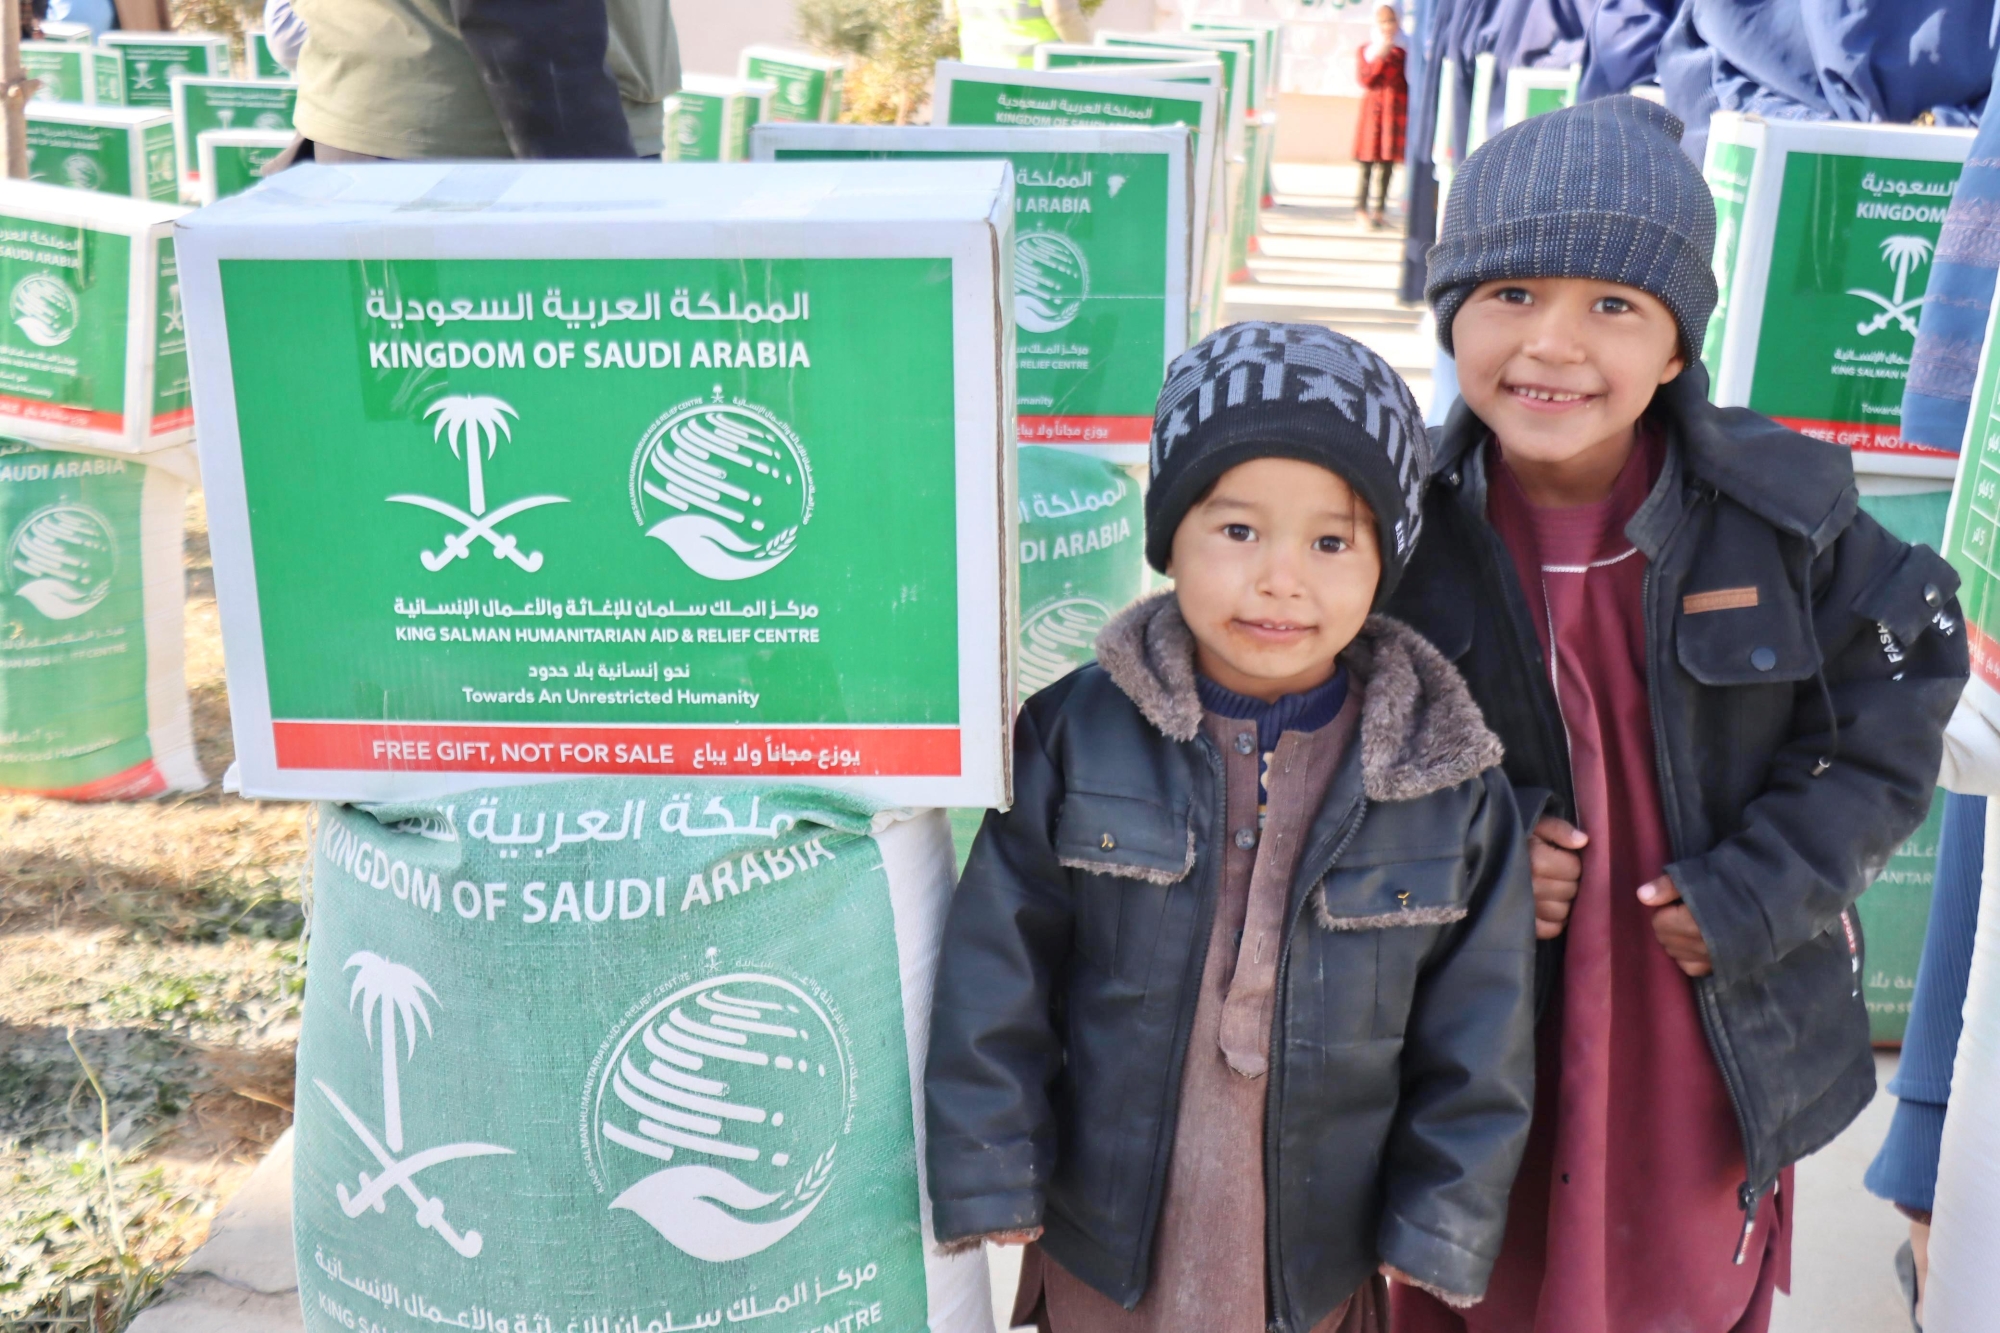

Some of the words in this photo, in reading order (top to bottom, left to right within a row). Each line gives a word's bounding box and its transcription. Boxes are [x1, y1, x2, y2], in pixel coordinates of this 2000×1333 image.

[1016, 168, 1092, 189] المملكة
[1025, 198, 1091, 213] ARABIA
[1856, 202, 1948, 224] KINGDOM
[366, 289, 533, 329] السعودية
[542, 289, 661, 329] العربية
[670, 288, 809, 324] المملكة
[369, 341, 525, 368] KINGDOM
[533, 342, 575, 368] OF
[584, 342, 681, 368] SAUDI
[689, 342, 811, 369] ARABIA
[1020, 361, 1050, 369] RELIEF
[1051, 361, 1089, 369] CENTRE
[1016, 396, 1054, 407] umanity
[0, 464, 49, 482] AUDI
[52, 459, 126, 479] ARABIA
[1033, 478, 1127, 518] المملكة
[1053, 518, 1131, 559] ARABIA
[394, 597, 479, 620] الإنسانية
[482, 596, 563, 619] والأعمال
[566, 597, 633, 619] للإغاثة
[635, 600, 707, 619] سلمان
[709, 600, 766, 618] الملك
[769, 600, 819, 620] مركز
[396, 627, 436, 642] KING
[440, 627, 512, 643] SALMAN
[516, 627, 646, 643] HUMANITARIAN
[650, 628, 679, 643] AID
[681, 628, 695, 643] &
[697, 628, 750, 643] RELIEF
[754, 628, 820, 643] CENTRE
[528, 664, 569, 680] حدود
[574, 660, 594, 679] بلا
[598, 660, 658, 681] إنسانية
[663, 663, 690, 679] نحو
[462, 686, 535, 704] Towards
[538, 687, 561, 704] An
[566, 688, 672, 705] Unrestricted
[677, 688, 760, 709] Humanity
[373, 740, 431, 760] FREE
[437, 741, 495, 764] GIFT,
[502, 743, 556, 762] NOT
[560, 743, 609, 763] FOR
[614, 744, 674, 764] SALE
[692, 743, 728, 769] يباع
[734, 744, 762, 767] ولا
[765, 736, 812, 763] مجاناً
[817, 746, 861, 767] يوزع
[467, 797, 646, 860] العربية
[321, 817, 440, 913] KINGDOM
[453, 880, 507, 922] OF
[522, 877, 665, 924] SAUDI
[680, 838, 836, 912] ARABIA
[579, 1043, 609, 1123] HUMANITARIAN
[605, 1025, 620, 1046] AID
[625, 994, 653, 1020] RELIEF
[653, 971, 690, 998] CENTRE
[314, 1243, 401, 1310] الإنسانية
[815, 1261, 877, 1305] مركز
[318, 1291, 355, 1330] KING
[726, 1281, 808, 1322] الملك
